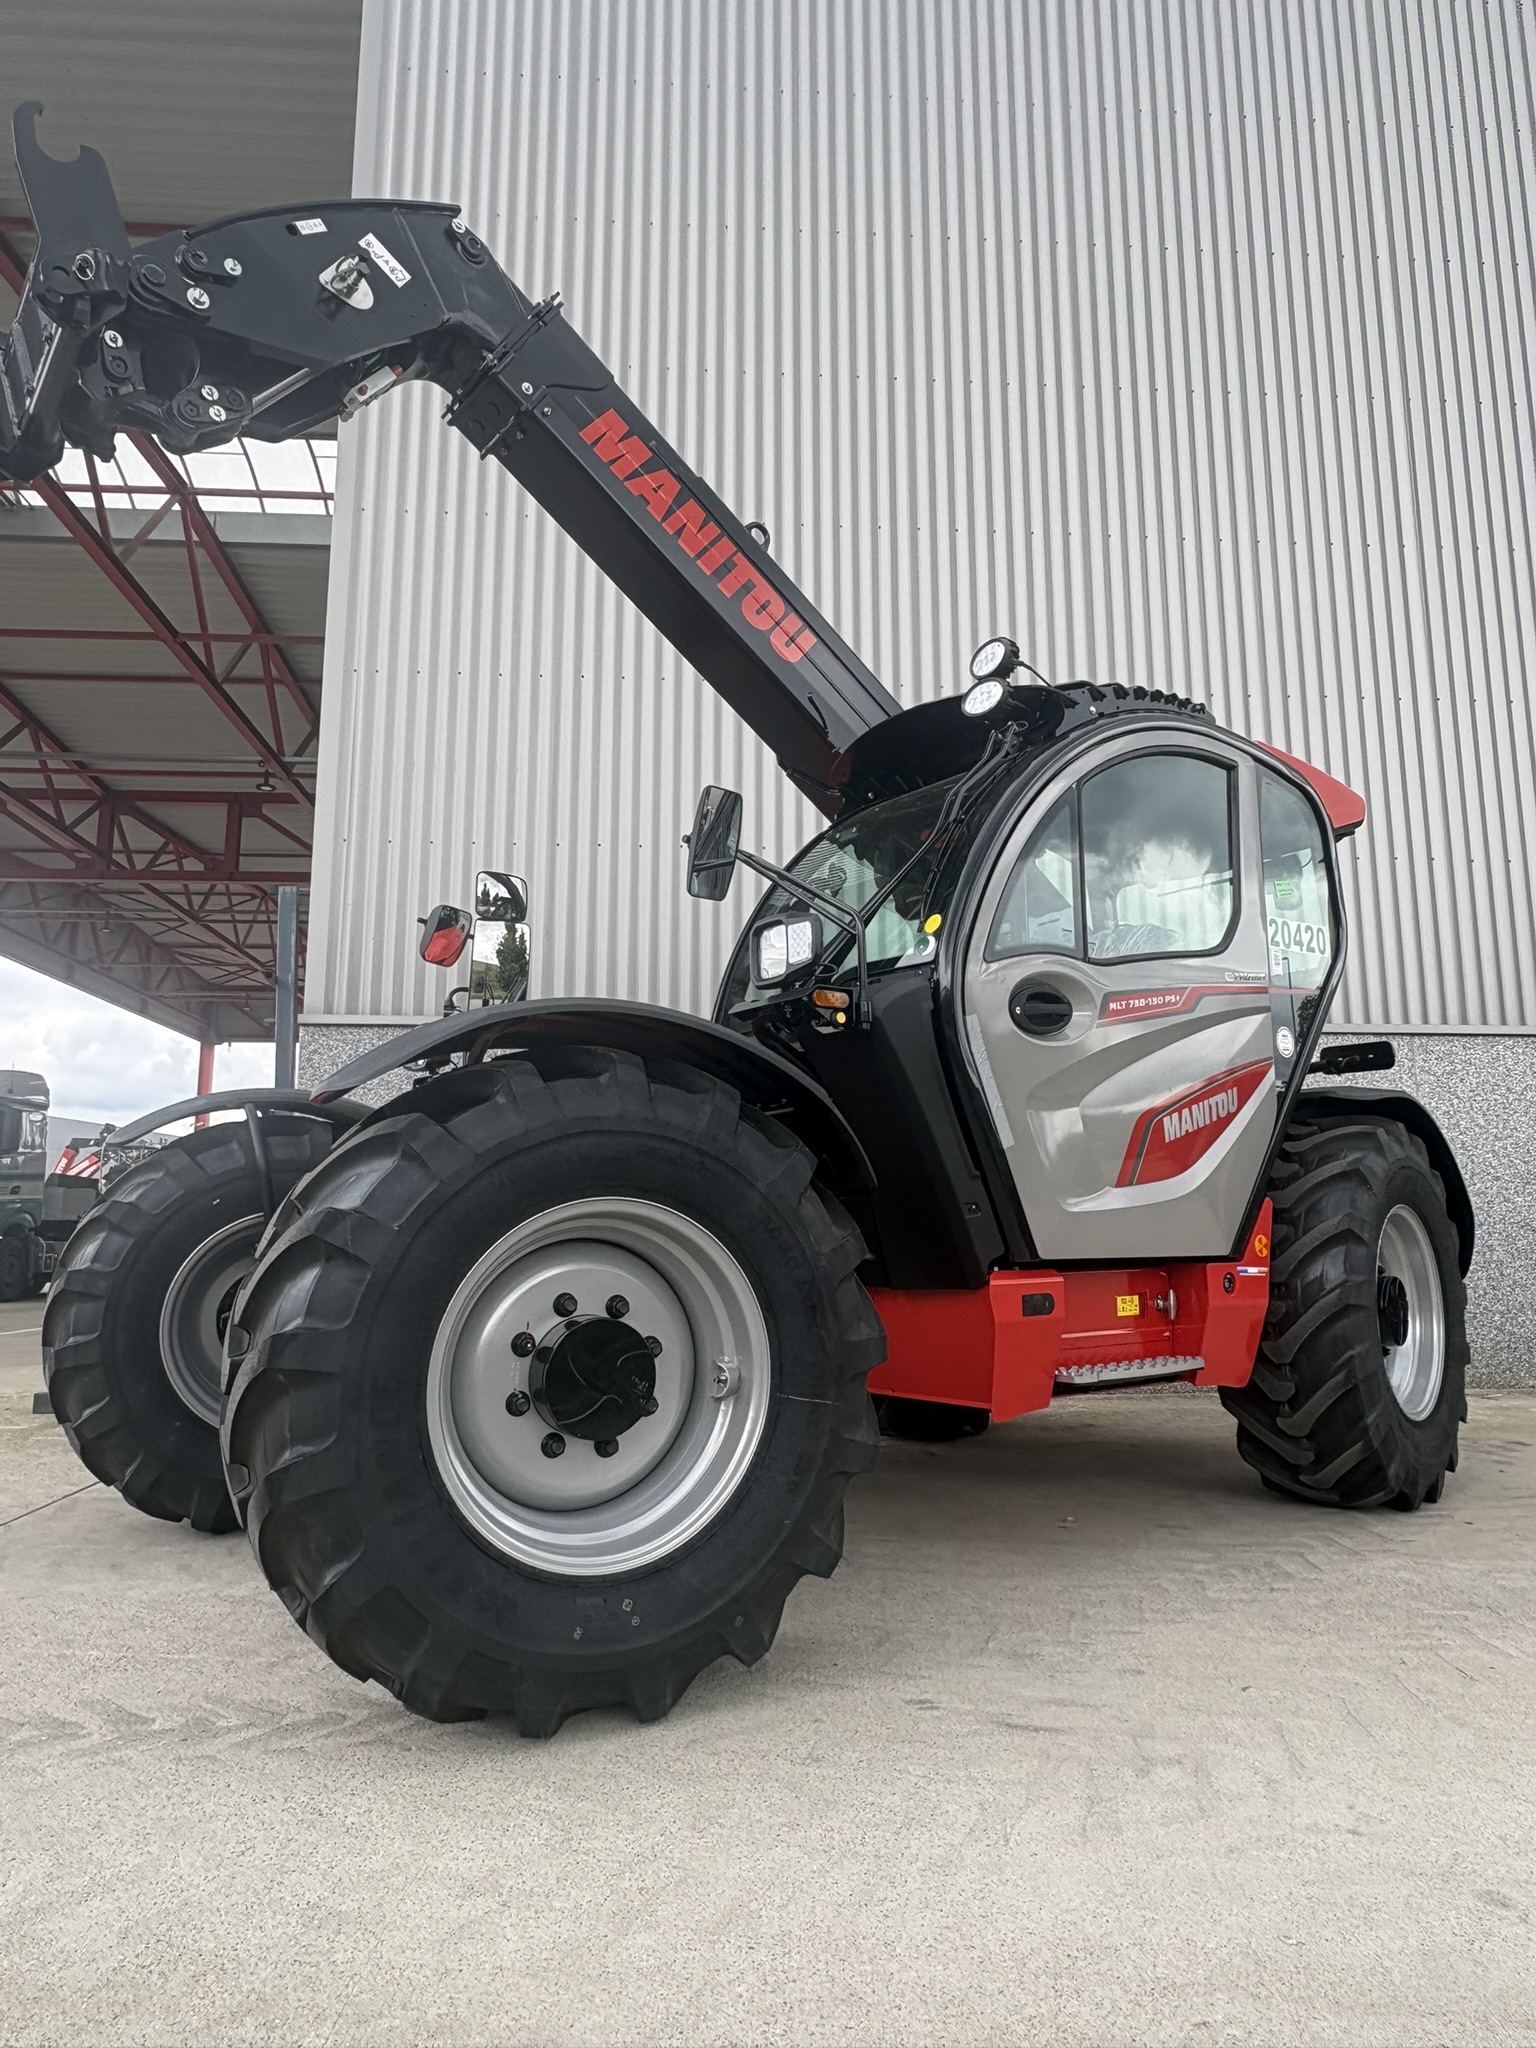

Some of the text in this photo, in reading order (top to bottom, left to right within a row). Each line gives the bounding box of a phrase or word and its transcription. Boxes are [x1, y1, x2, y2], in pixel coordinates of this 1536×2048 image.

[578, 407, 818, 663] MANITOU
[1268, 918, 1326, 955] 20420
[1109, 1001, 1127, 1011] MLT
[1162, 1086, 1238, 1143] MANITOU
